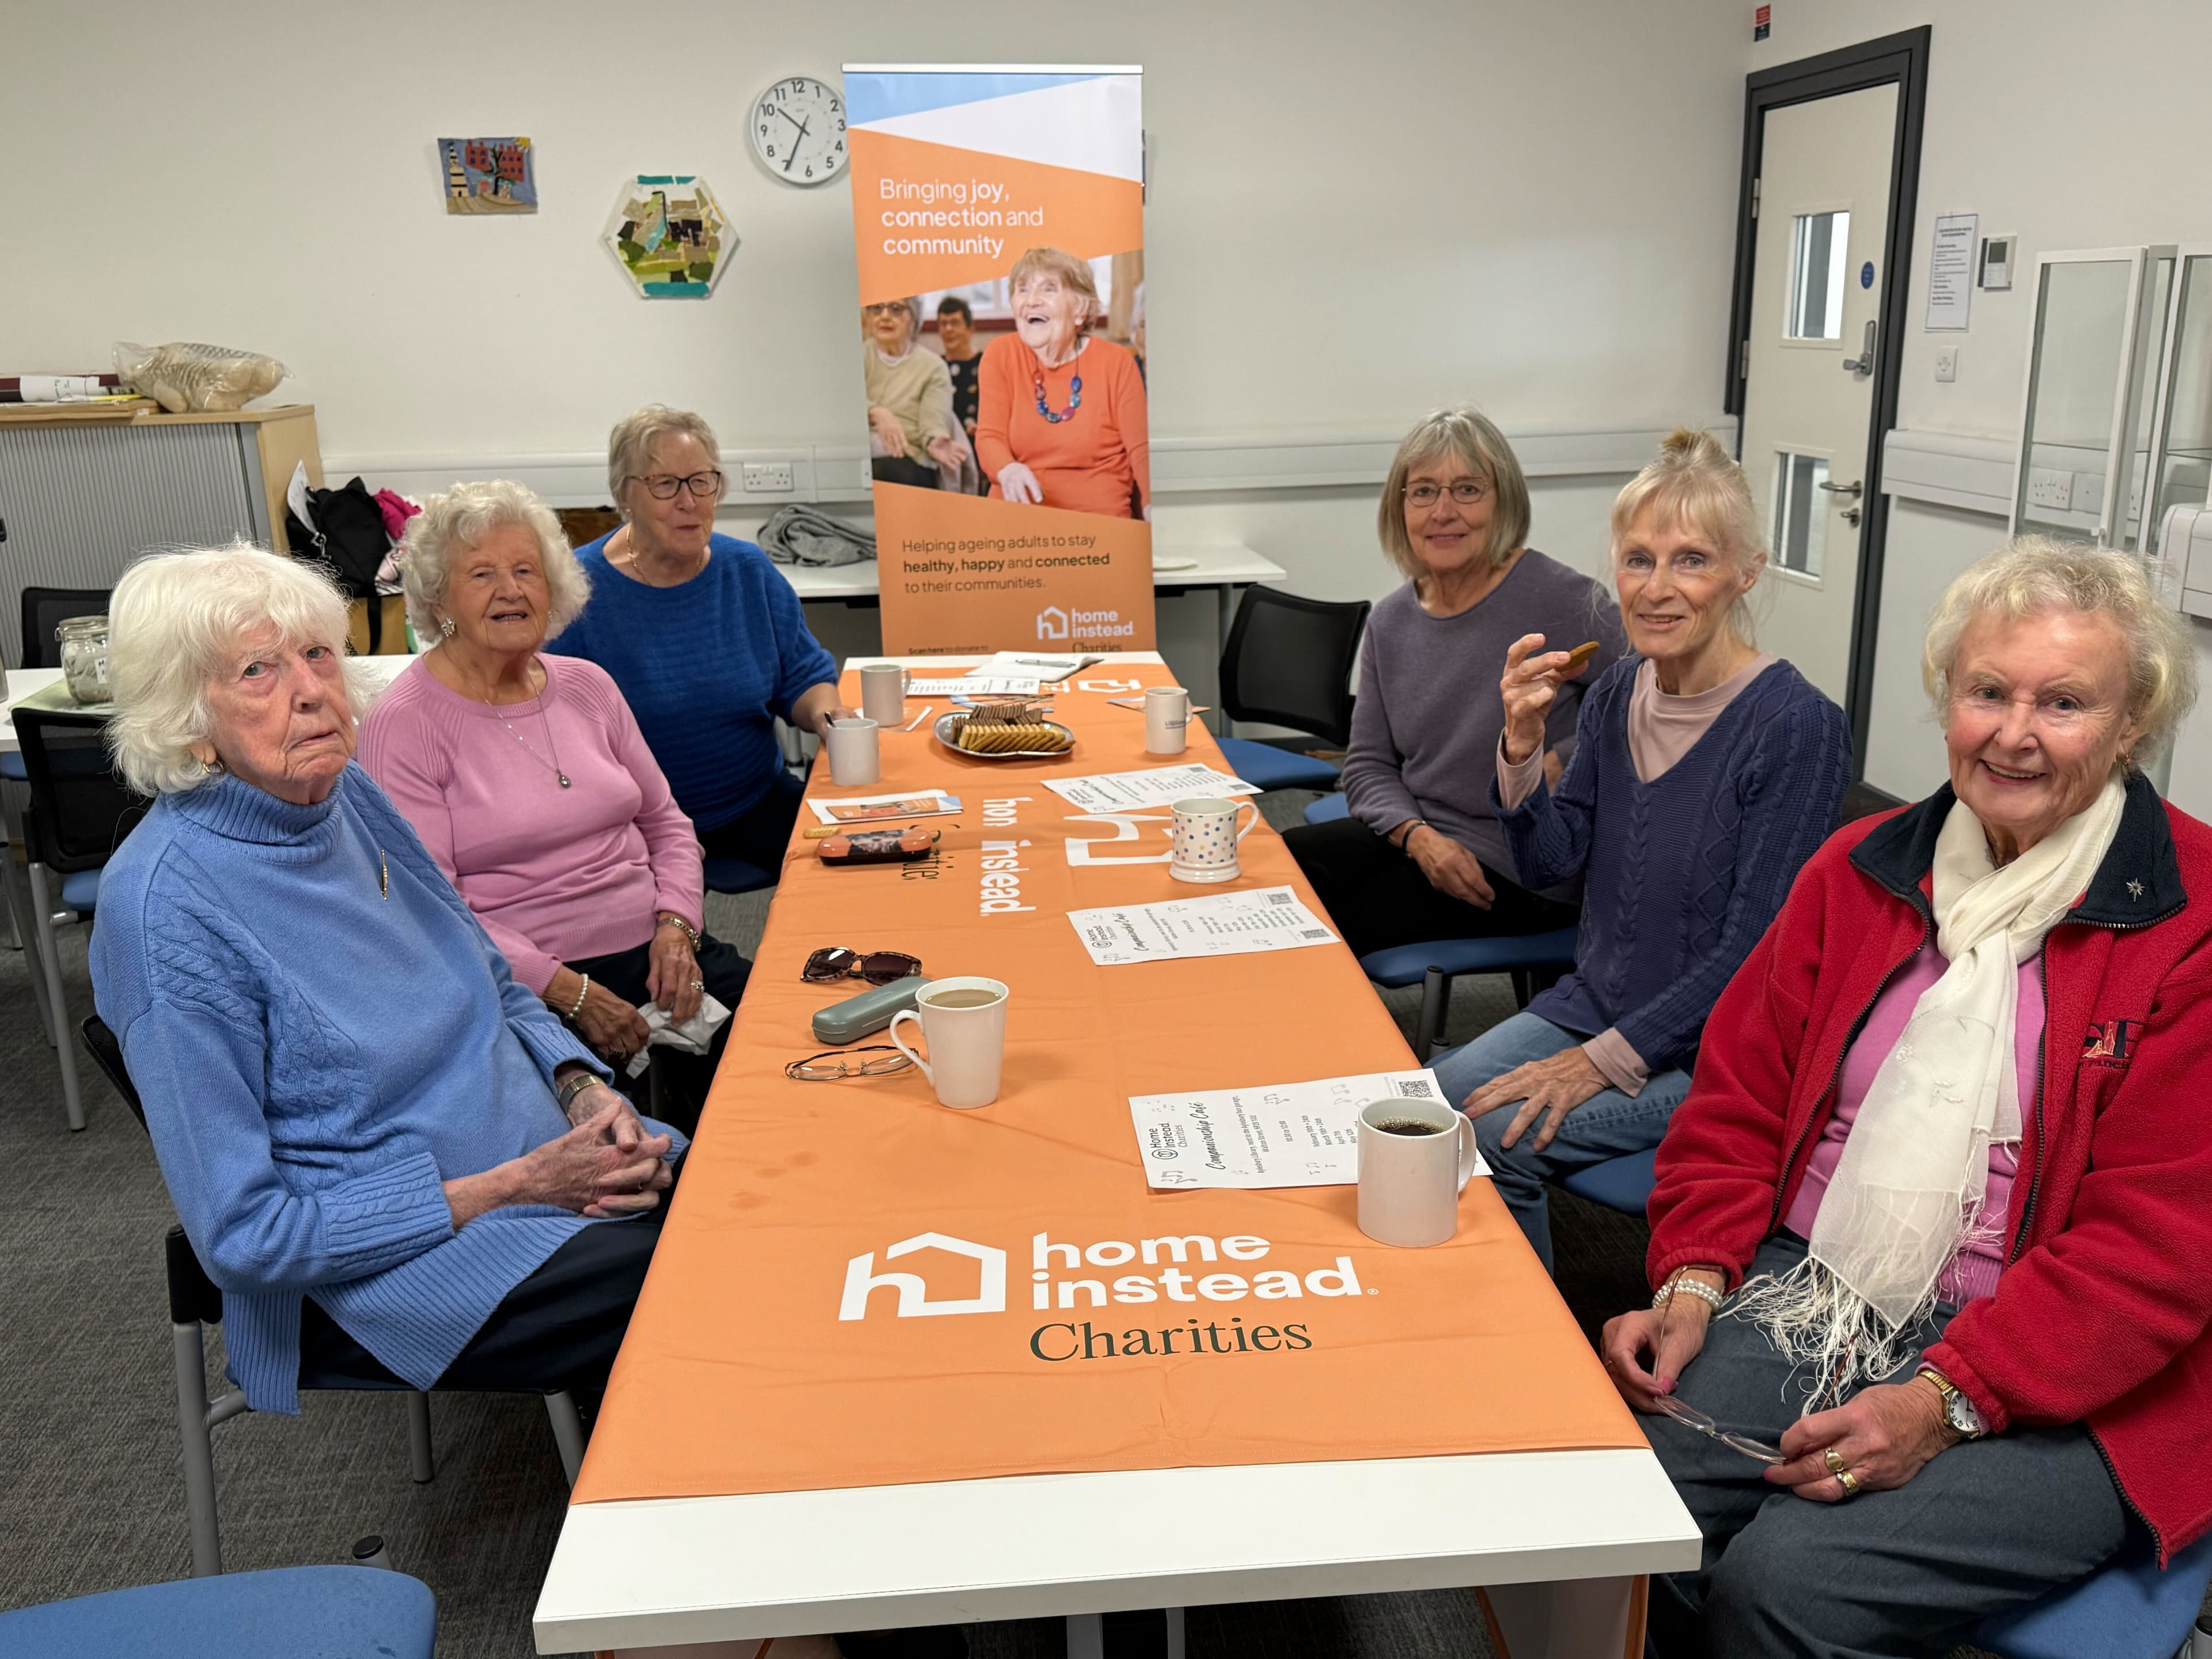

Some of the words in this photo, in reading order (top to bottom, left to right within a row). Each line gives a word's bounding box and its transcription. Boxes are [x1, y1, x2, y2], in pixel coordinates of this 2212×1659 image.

[774, 88, 786, 101] 11
[791, 80, 805, 93] 12
[815, 85, 820, 98] 1
[761, 103, 775, 116] 10
[831, 99, 839, 112] 2
[760, 124, 768, 137] 9
[838, 119, 846, 132] 3
[767, 145, 775, 157] 8
[835, 141, 843, 152] 4
[782, 160, 790, 171] 7
[805, 165, 813, 177] 6
[826, 157, 834, 169] 5
[880, 178, 966, 204] Bringing
[970, 178, 1009, 203] joy,
[881, 207, 1002, 226] connection
[1006, 206, 1043, 226] and
[883, 234, 1004, 259] community
[902, 539, 956, 554] Helping
[959, 537, 1006, 552] ageing
[1008, 536, 1049, 548] adults
[1051, 536, 1066, 547] to
[1068, 535, 1096, 548] stay
[903, 559, 959, 574] healthy,
[961, 558, 1005, 572] happy
[1008, 556, 1032, 569] and
[1035, 553, 1110, 567] connected
[905, 582, 919, 593] to
[922, 579, 952, 593] their
[955, 576, 1046, 592] communities.
[1071, 608, 1118, 623] home
[1072, 620, 1134, 638] instead
[1073, 641, 1122, 653] Charities
[1188, 1102, 1209, 1119] Café
[1149, 1128, 1162, 1148] Home
[1158, 1122, 1176, 1147] Instead
[1174, 1124, 1188, 1147] Charities
[1196, 1120, 1226, 1170] Companionship
[1033, 1232, 1271, 1270] home
[1032, 1256, 1362, 1310] instead
[1029, 1317, 1313, 1362] Charities
